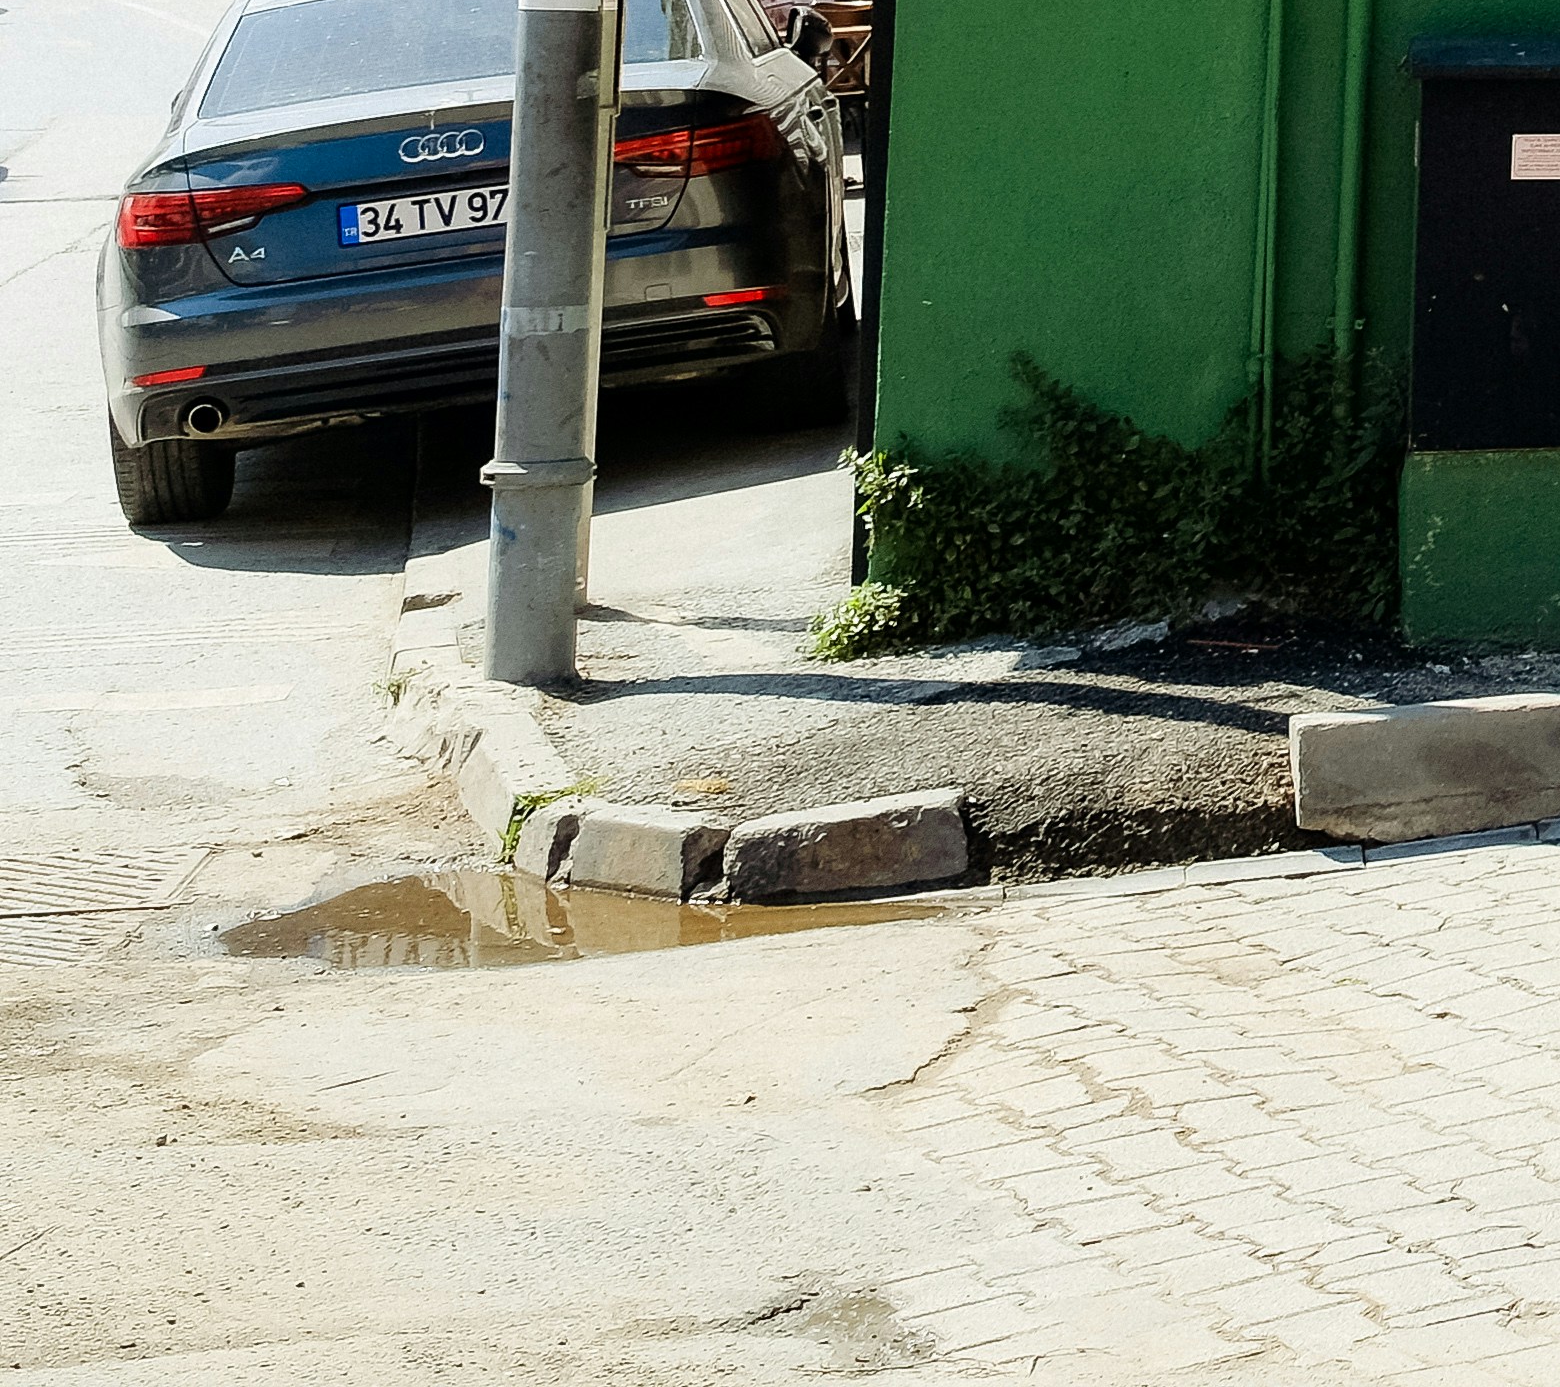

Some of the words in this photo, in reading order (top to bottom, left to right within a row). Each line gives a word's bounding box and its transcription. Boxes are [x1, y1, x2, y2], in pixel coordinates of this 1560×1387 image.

[360, 204, 404, 238] 34
[411, 195, 458, 230] TV
[228, 247, 265, 264] A4
